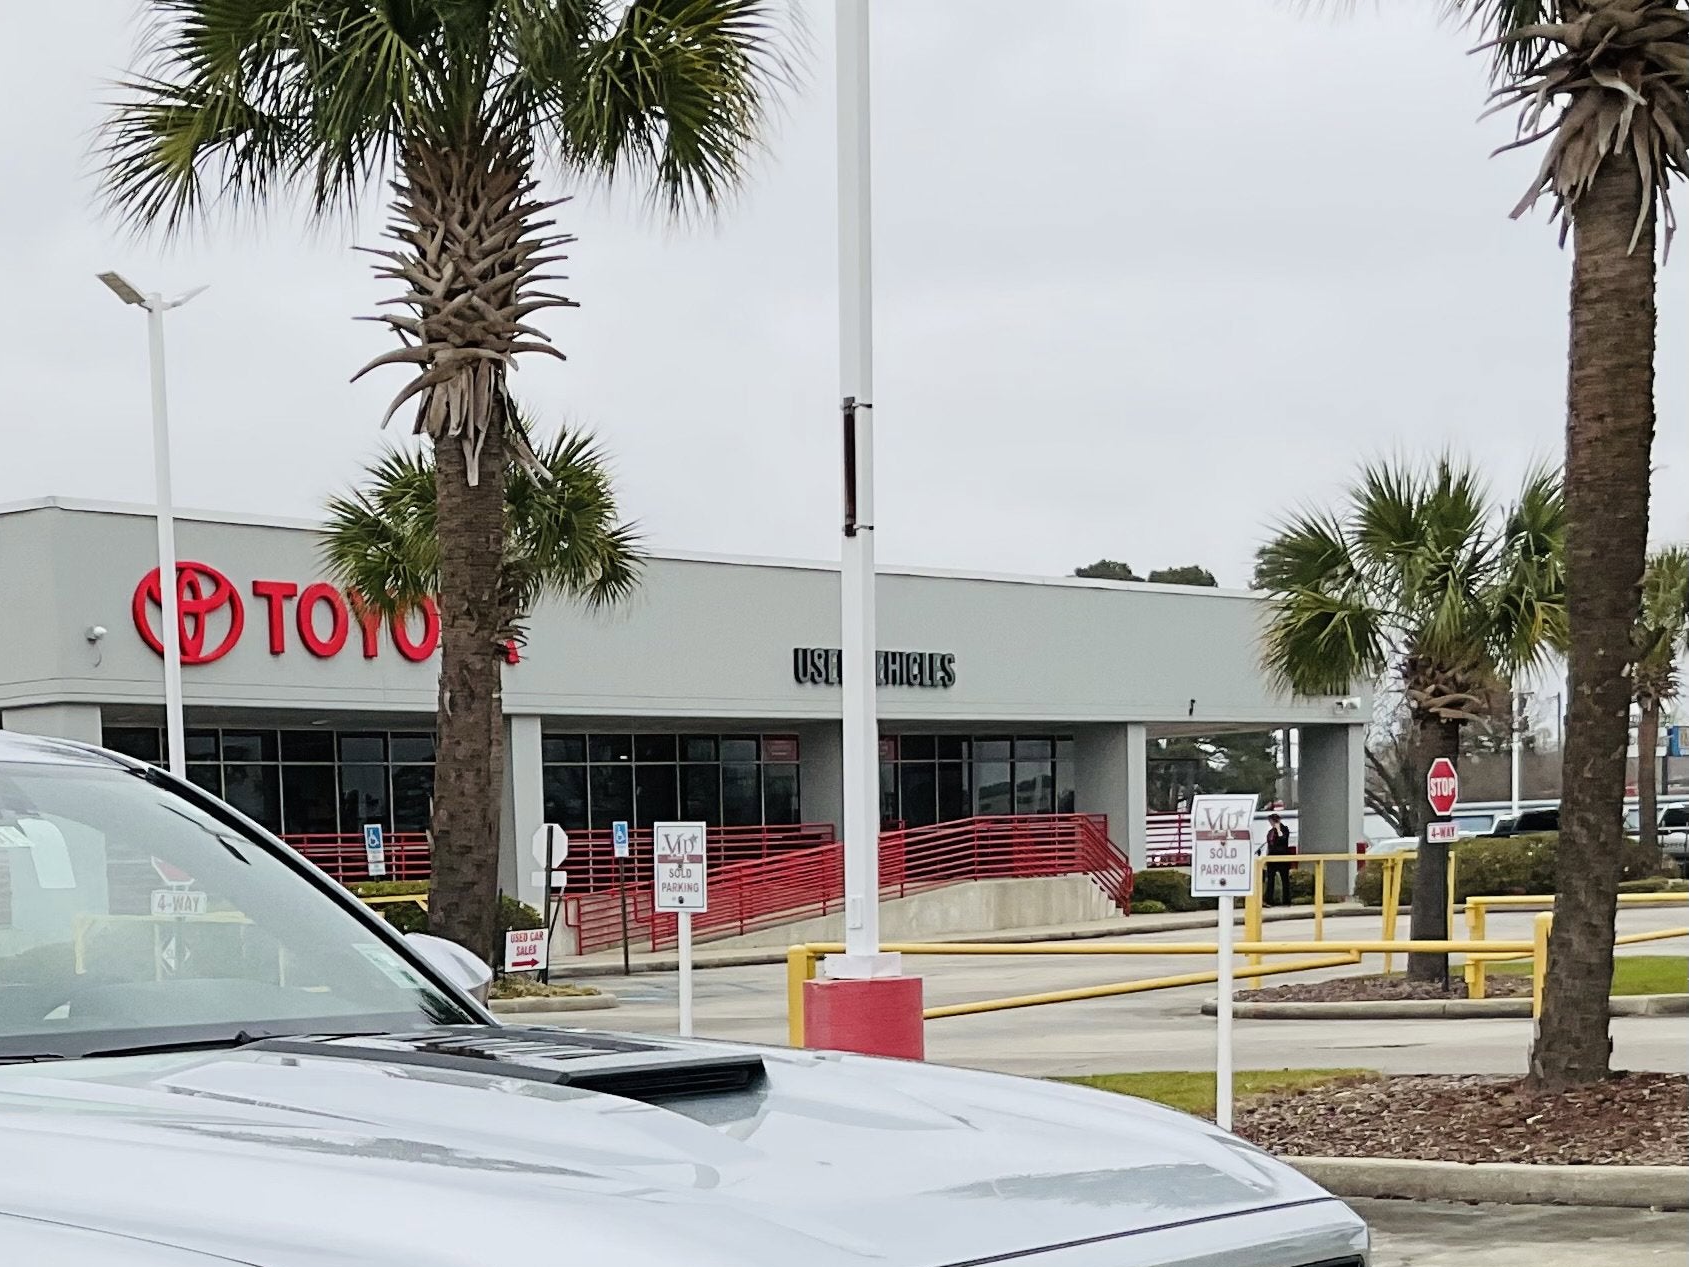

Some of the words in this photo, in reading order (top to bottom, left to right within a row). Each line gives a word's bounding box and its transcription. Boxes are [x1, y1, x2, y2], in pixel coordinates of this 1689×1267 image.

[252, 579, 520, 665] TOYO
[793, 647, 843, 685] USE
[875, 650, 957, 689] EHICLES
[1430, 776, 1455, 797] STOP
[1431, 826, 1456, 839] 4-WAY
[1209, 847, 1238, 859] SOLD
[669, 868, 692, 879] SOLD
[1200, 863, 1246, 875] PARKING
[661, 882, 700, 893] PARKING
[157, 894, 199, 912] 4-WAY
[511, 932, 528, 943] USED
[530, 931, 544, 941] CAR
[516, 944, 537, 956] SALES
